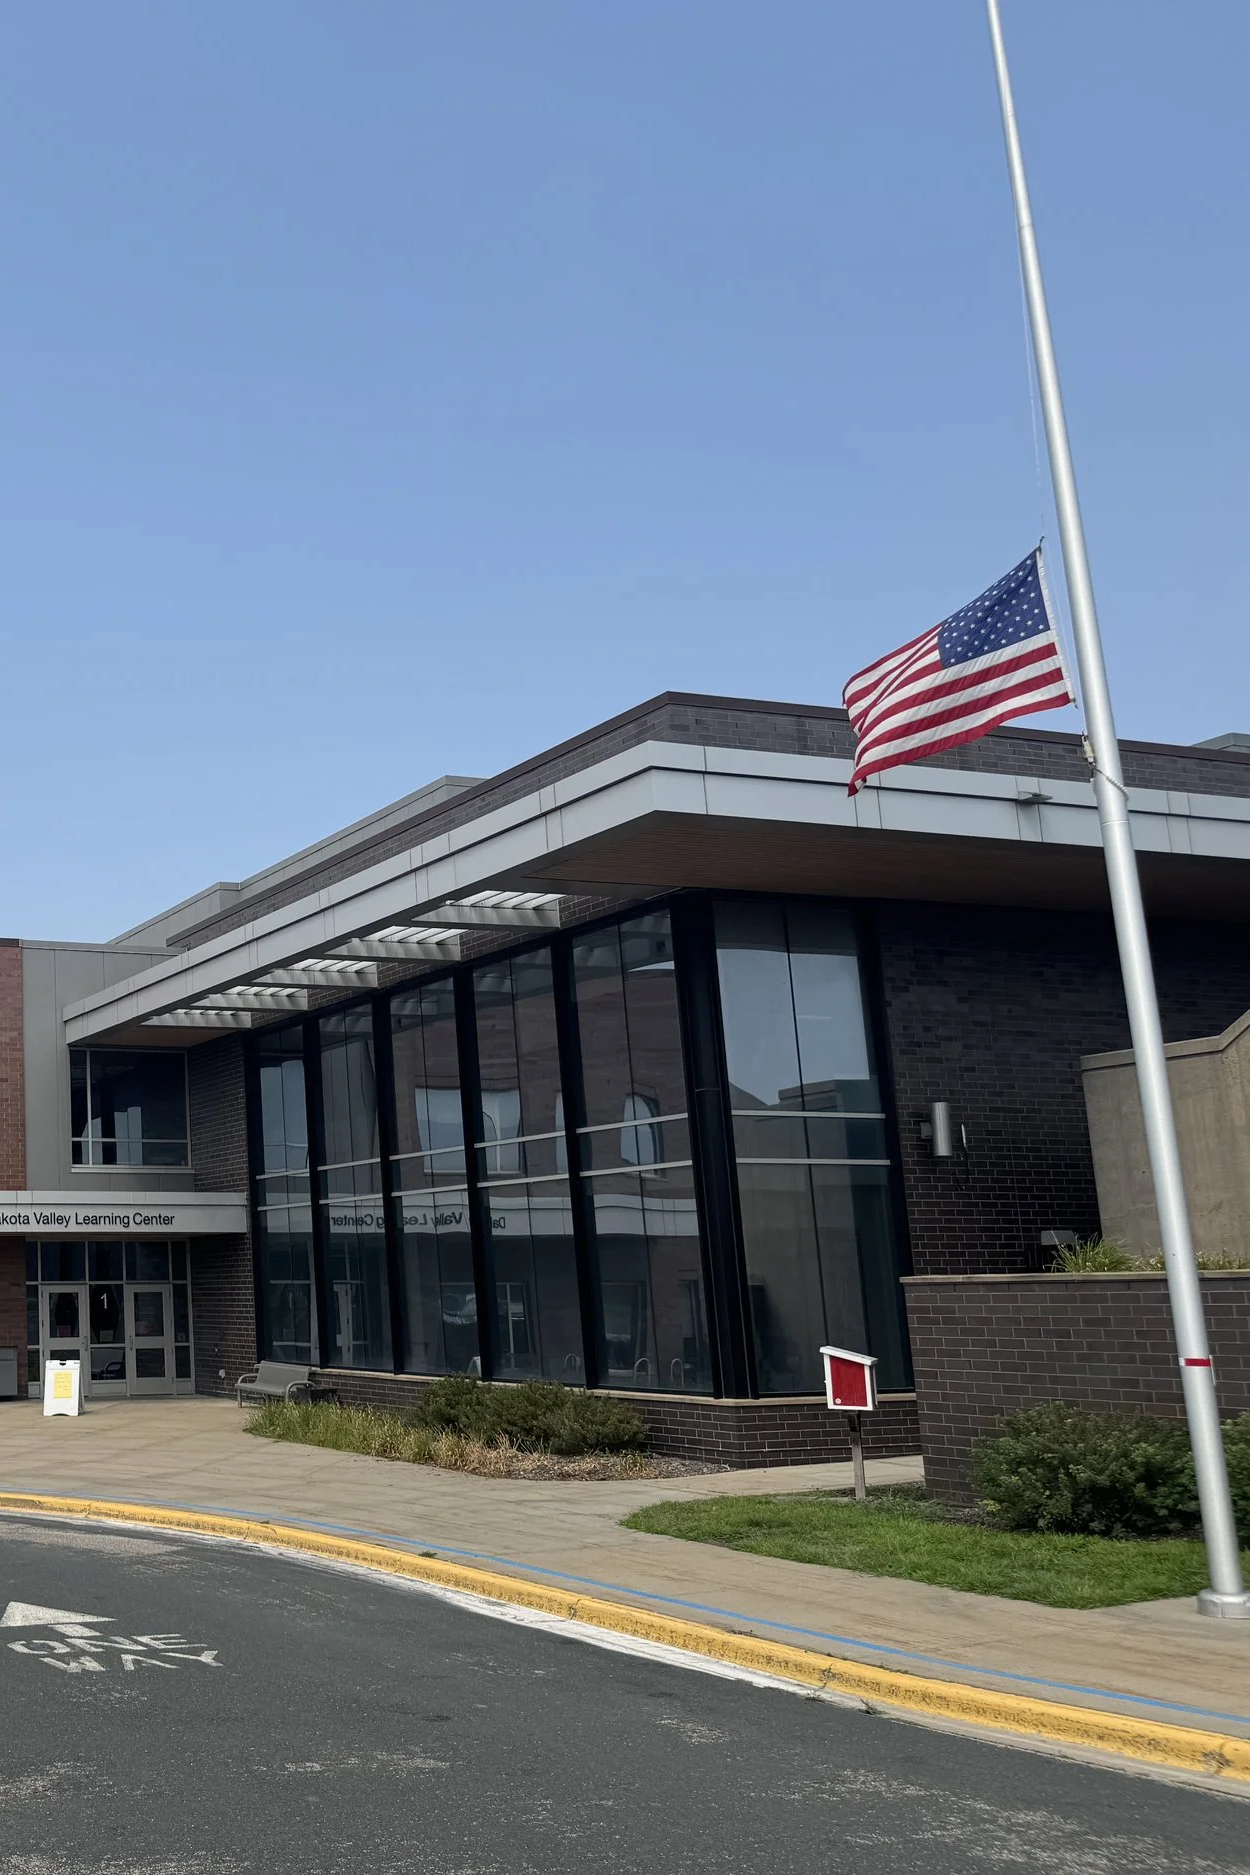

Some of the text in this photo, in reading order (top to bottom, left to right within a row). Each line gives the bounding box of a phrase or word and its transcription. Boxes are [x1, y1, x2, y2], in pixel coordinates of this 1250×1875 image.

[33, 1212, 71, 1228] Valley
[74, 1212, 130, 1228] Learning
[132, 1212, 175, 1226] Center
[100, 1293, 107, 1309] 1
[6, 1633, 208, 1655] ONE
[37, 1650, 224, 1674] WAY
